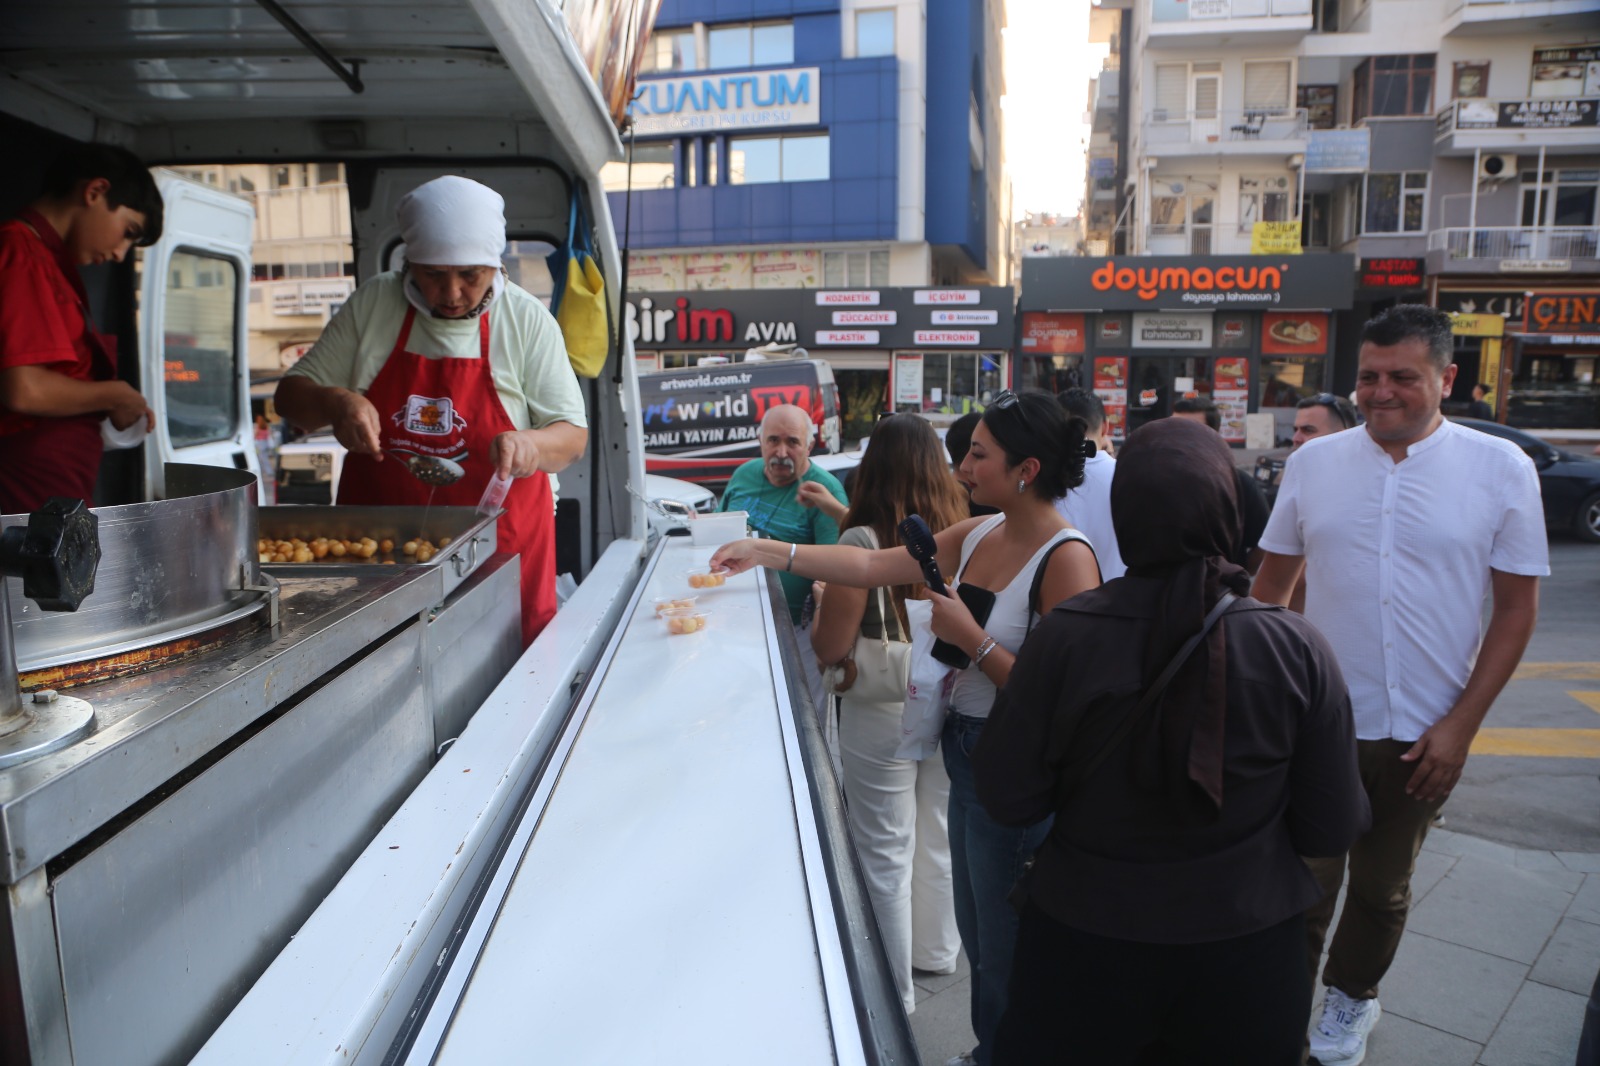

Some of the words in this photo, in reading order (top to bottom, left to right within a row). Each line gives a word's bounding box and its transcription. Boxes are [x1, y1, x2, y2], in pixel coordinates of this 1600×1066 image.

[627, 72, 810, 115] KUANTUM
[1091, 260, 1281, 300] doymacun
[825, 294, 871, 302] KOZMETİK
[1533, 297, 1600, 331] ÇIN
[744, 321, 797, 342] AVM
[828, 333, 866, 342] PLASTİK
[918, 333, 976, 342] ELEKTRONİK
[660, 373, 752, 391] artworld.com.tr
[641, 398, 676, 425] rt
[685, 429, 724, 443] YAYIN
